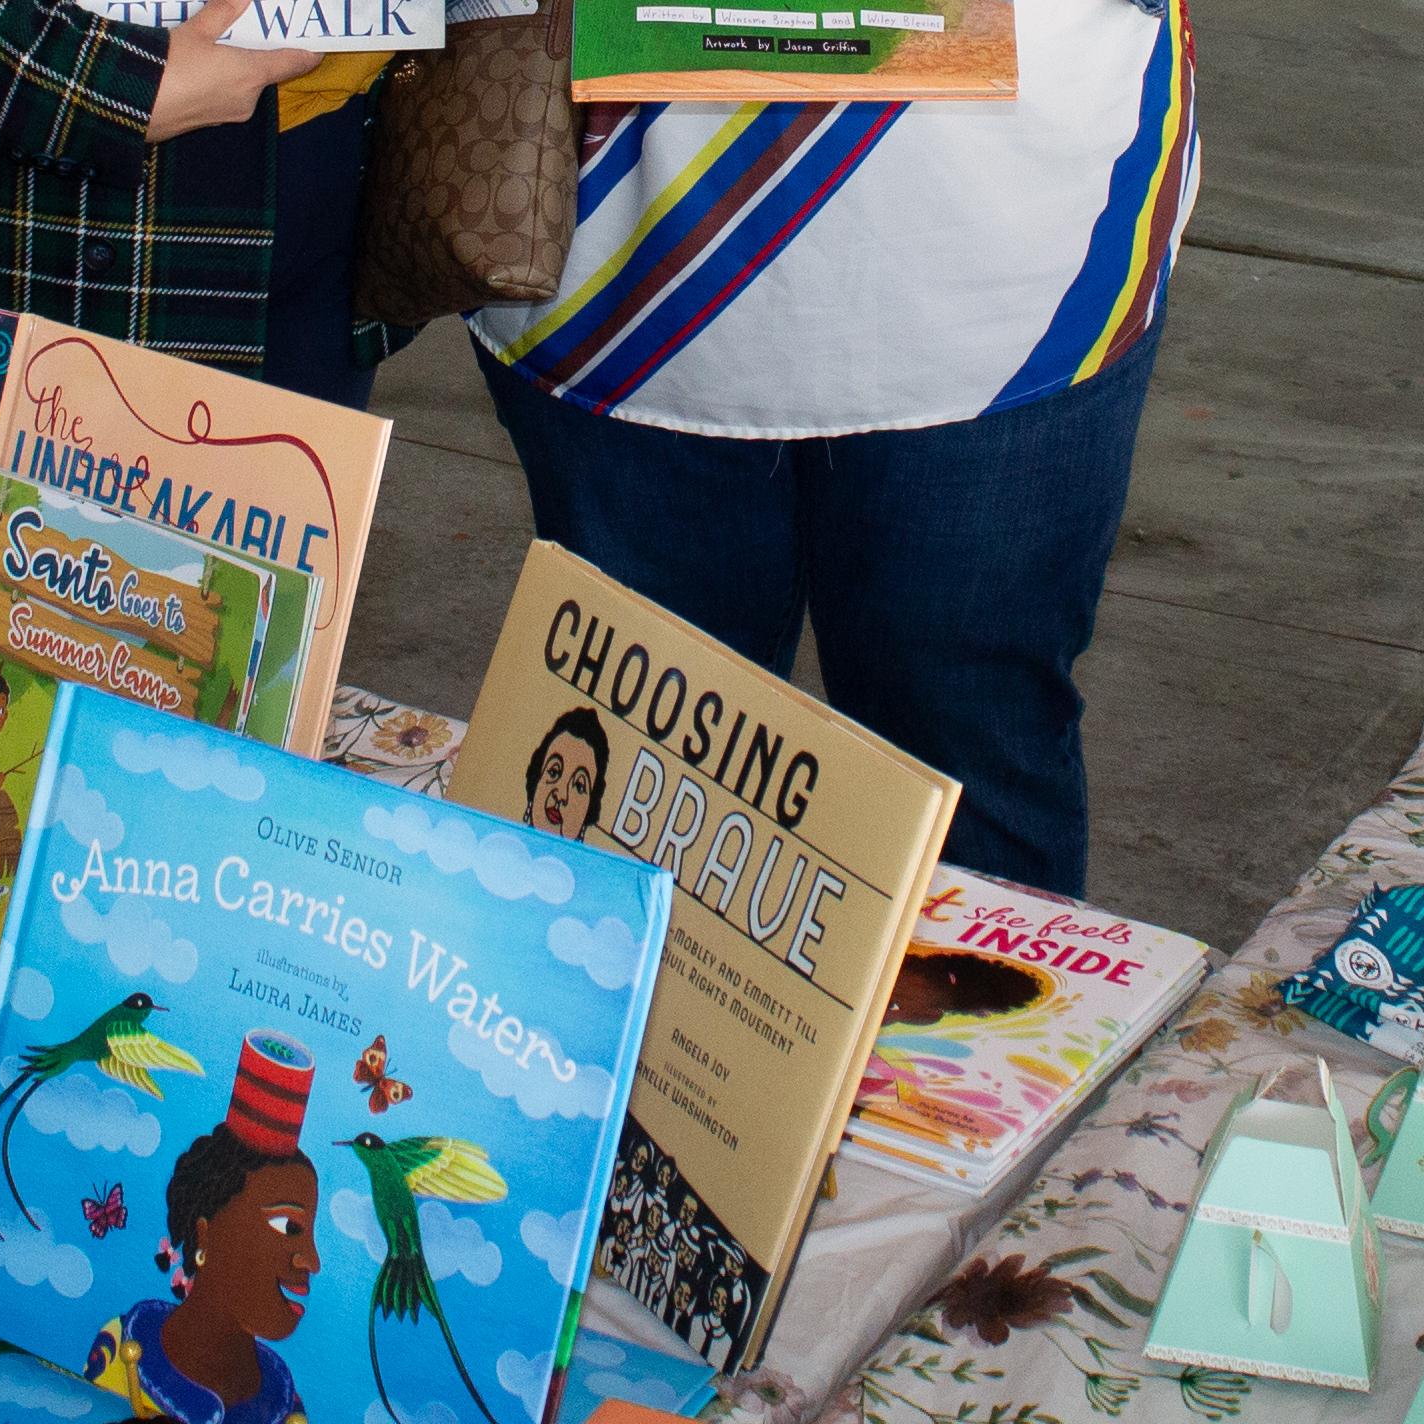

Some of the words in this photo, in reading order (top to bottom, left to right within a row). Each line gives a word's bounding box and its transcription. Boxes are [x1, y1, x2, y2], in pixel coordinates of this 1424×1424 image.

[641, 6, 688, 22] Written
[691, 10, 707, 25] by
[722, 13, 768, 27] Winsome
[773, 13, 816, 29] Bingham
[831, 16, 852, 27] and
[866, 13, 897, 28] Wiley
[902, 15, 943, 30] Blevins
[705, 38, 748, 51] Artwork
[758, 40, 771, 53] by
[784, 41, 814, 53] Jason
[822, 39, 859, 54] Griffin
[35, 385, 84, 444] the
[3, 506, 116, 615] Santo
[118, 570, 161, 624] Goes
[166, 595, 186, 634] to
[8, 602, 108, 678] Summer
[107, 642, 182, 711] Camp
[543, 598, 821, 832] CHOOSING
[611, 746, 847, 979] BRAVE
[956, 921, 1145, 987] INSIDE
[963, 906, 1034, 928] she
[1037, 912, 1134, 946] feels
[51, 837, 201, 904] Anna
[213, 856, 393, 971] Carries
[402, 927, 577, 1083] Water
[256, 947, 332, 989] illustrations
[332, 975, 351, 1003] by
[228, 967, 293, 1013] LAURA
[296, 992, 364, 1037] JAMES
[688, 967, 728, 1007] RIGHTS
[729, 997, 795, 1056] MOVEMENT
[717, 961, 742, 988] AND
[743, 979, 793, 1024] EMMETT
[795, 1015, 819, 1045] TILL
[663, 1061, 706, 1100] ILLUSTRATED
[671, 1028, 710, 1068] ANGELA
[709, 1056, 731, 1083] JOY
[671, 1086, 740, 1152] WASHINGTON
